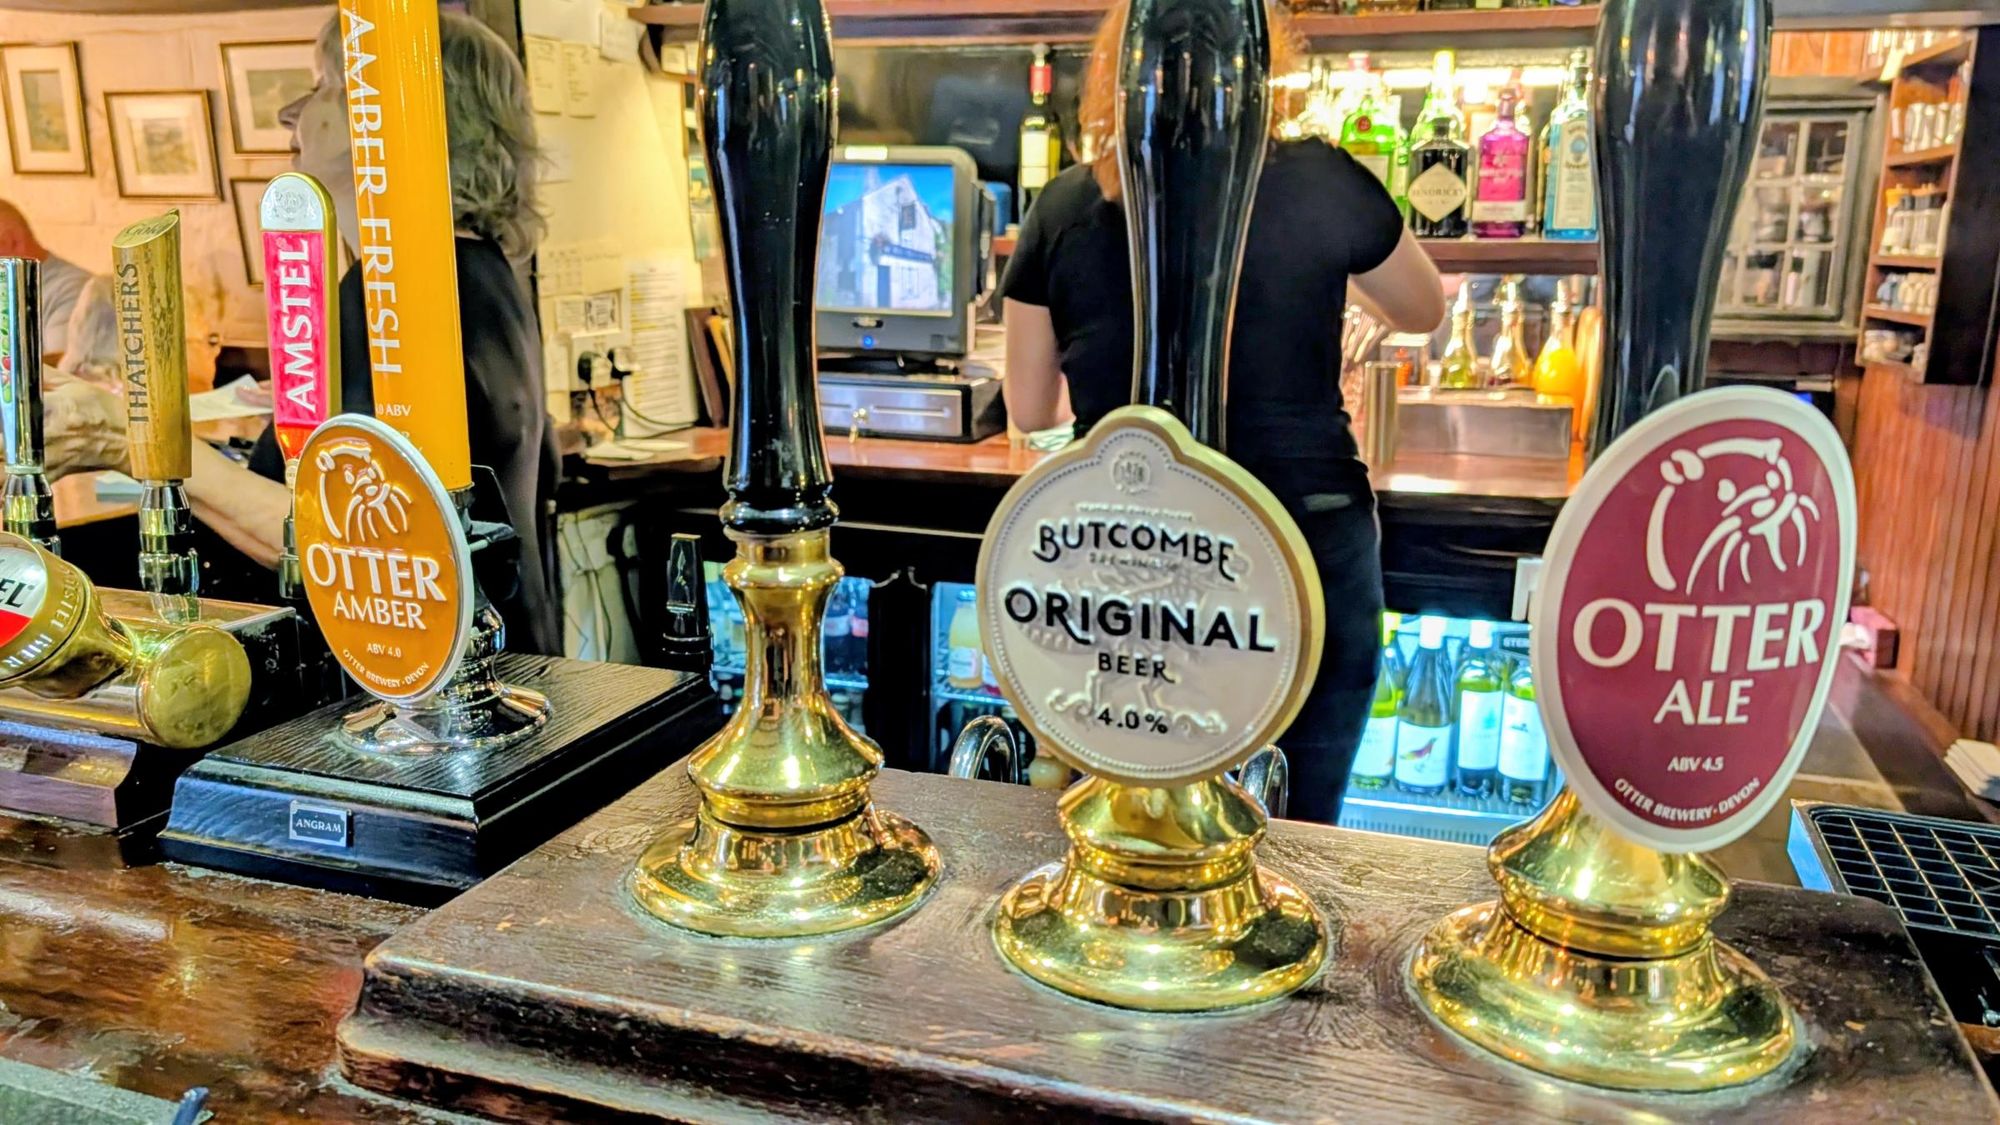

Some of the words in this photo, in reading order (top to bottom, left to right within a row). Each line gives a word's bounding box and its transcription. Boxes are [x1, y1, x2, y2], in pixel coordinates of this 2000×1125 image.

[342, 7, 388, 197] AMBER
[361, 217, 403, 374] FRESH
[116, 263, 149, 427] THATCHERS
[279, 238, 317, 413] AMSTEL
[385, 402, 412, 416] ABV
[306, 542, 448, 602] OTTER
[1033, 521, 1236, 583] BUTCOMBE
[0, 577, 27, 609] EL
[333, 591, 428, 631] AMBER
[1004, 586, 1276, 653] ORIGINAL
[1572, 597, 1826, 674] OTTER
[342, 649, 366, 675] OTTER
[366, 669, 401, 688] BREWERY
[404, 662, 430, 685] DEVON
[367, 643, 385, 655] ABV
[387, 647, 402, 658] 4.0
[1097, 651, 1177, 685] BEER
[1096, 706, 1170, 735] 4.0%
[1652, 678, 1755, 726] ALE
[1667, 756, 1701, 771] ABV
[1702, 756, 1724, 771] 4.5
[1614, 777, 1654, 812] OTTER
[1653, 803, 1714, 822] BREWERY
[1718, 777, 1761, 814] DEVON
[295, 817, 343, 834] ANGRAM
